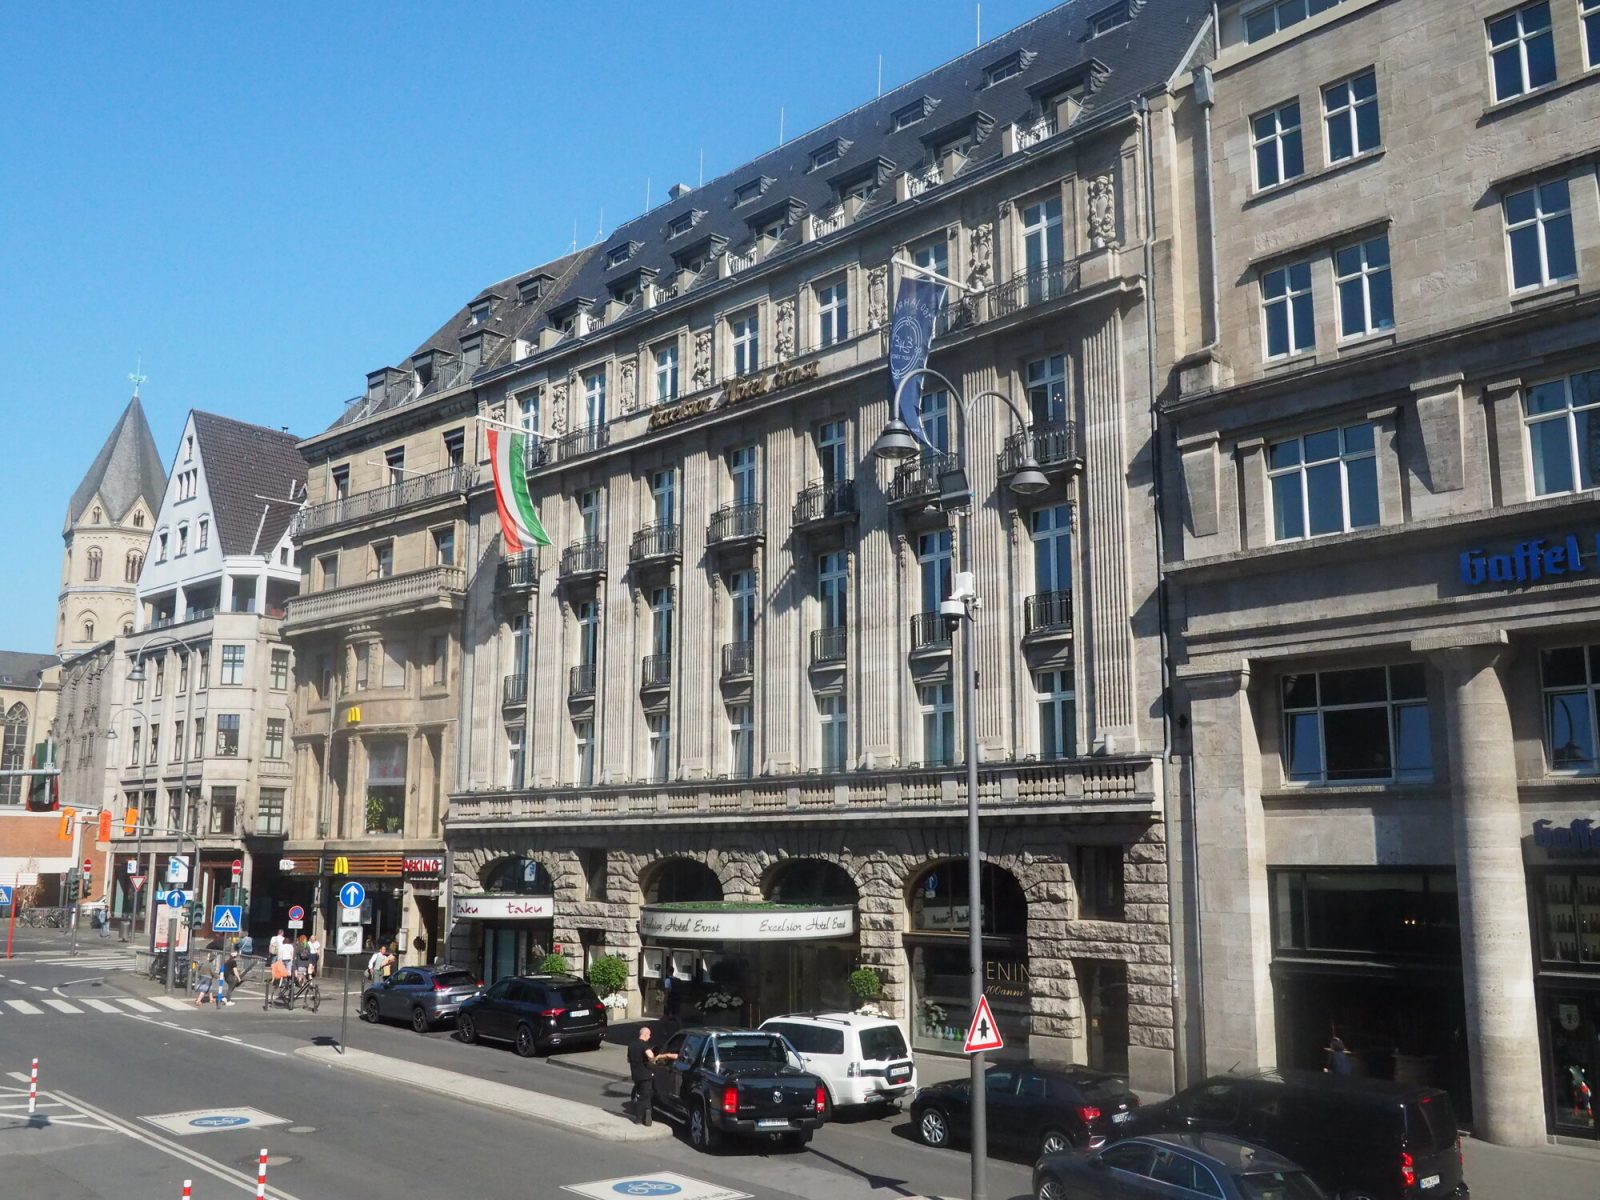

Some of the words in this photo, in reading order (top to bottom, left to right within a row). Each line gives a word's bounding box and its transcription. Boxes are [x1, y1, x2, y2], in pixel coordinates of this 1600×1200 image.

[1459, 533, 1585, 585] Gaffel
[456, 902, 479, 914] taku
[505, 901, 543, 914] taku
[664, 916, 691, 932] Hotel
[693, 919, 721, 932] Ernst
[759, 919, 802, 932] Excelsior
[805, 915, 831, 930] Hotel
